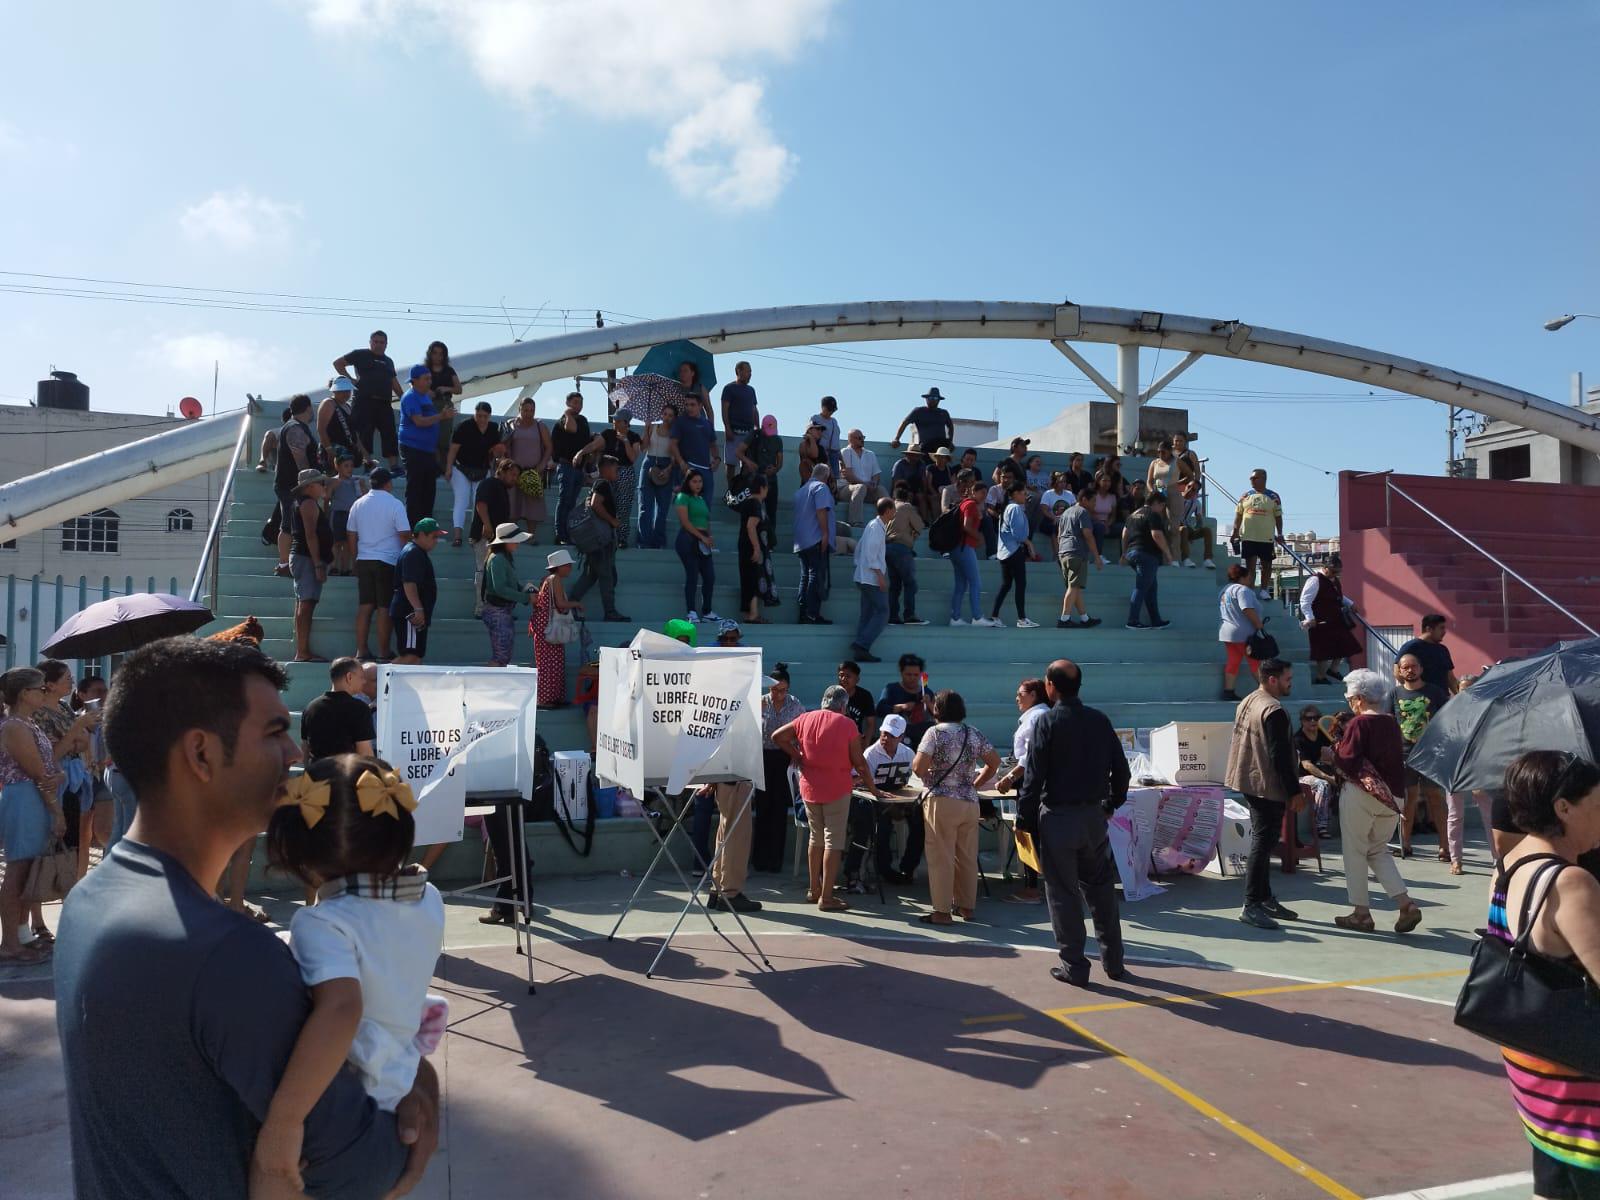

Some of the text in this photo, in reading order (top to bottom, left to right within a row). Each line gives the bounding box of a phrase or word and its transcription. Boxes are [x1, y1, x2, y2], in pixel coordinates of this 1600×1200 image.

[646, 673, 660, 686] EL
[688, 692, 742, 712] EL VOTO ES
[652, 710, 684, 723] SECR
[693, 709, 722, 726] LIBRE
[401, 731, 413, 745] EL
[417, 730, 445, 744] VOTO
[448, 728, 461, 742] ES
[686, 723, 726, 740] SECRET
[410, 746, 451, 762] LIBRE Y
